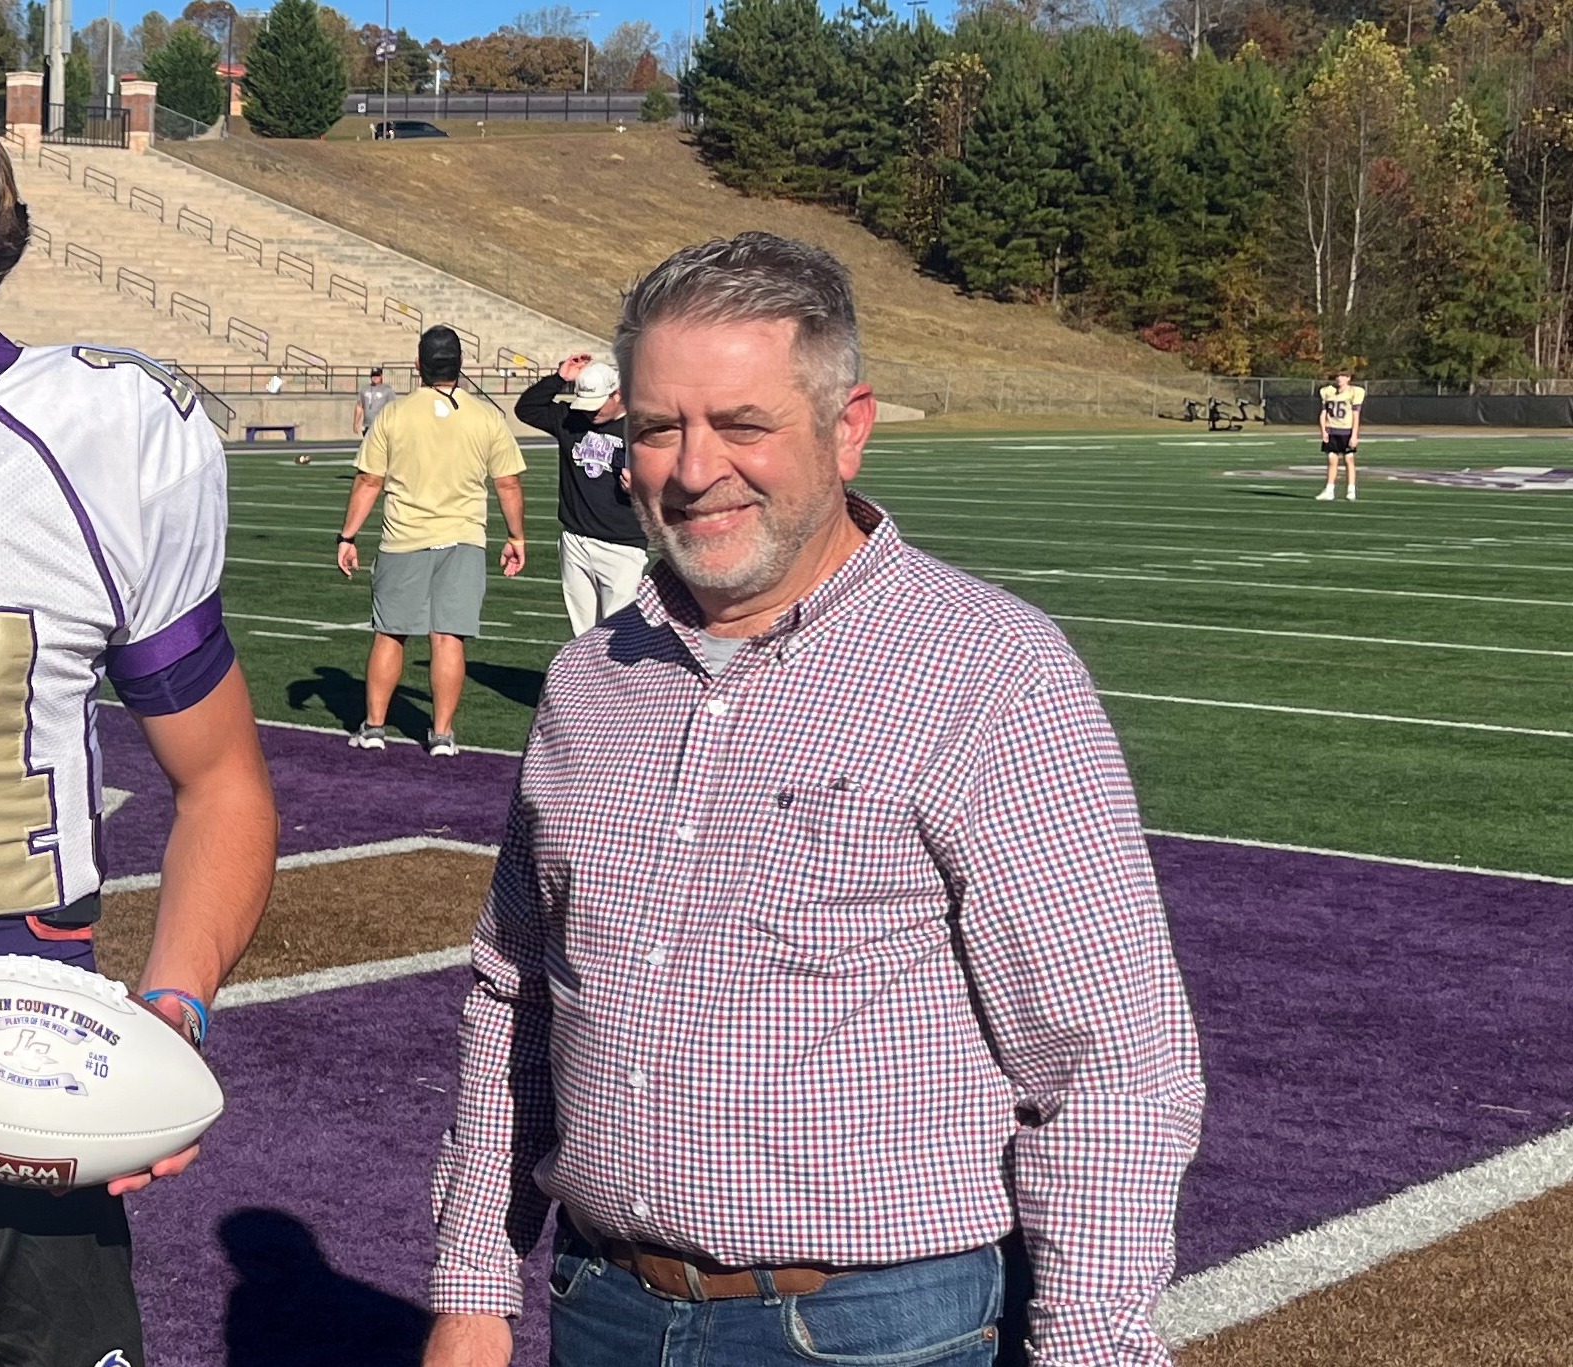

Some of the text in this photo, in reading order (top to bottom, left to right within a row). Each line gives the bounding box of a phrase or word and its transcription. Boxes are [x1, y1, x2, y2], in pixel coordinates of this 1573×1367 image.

[16, 998, 70, 1020] COUNTY
[69, 1010, 121, 1047] INDIANS
[85, 1059, 109, 1078] #10
